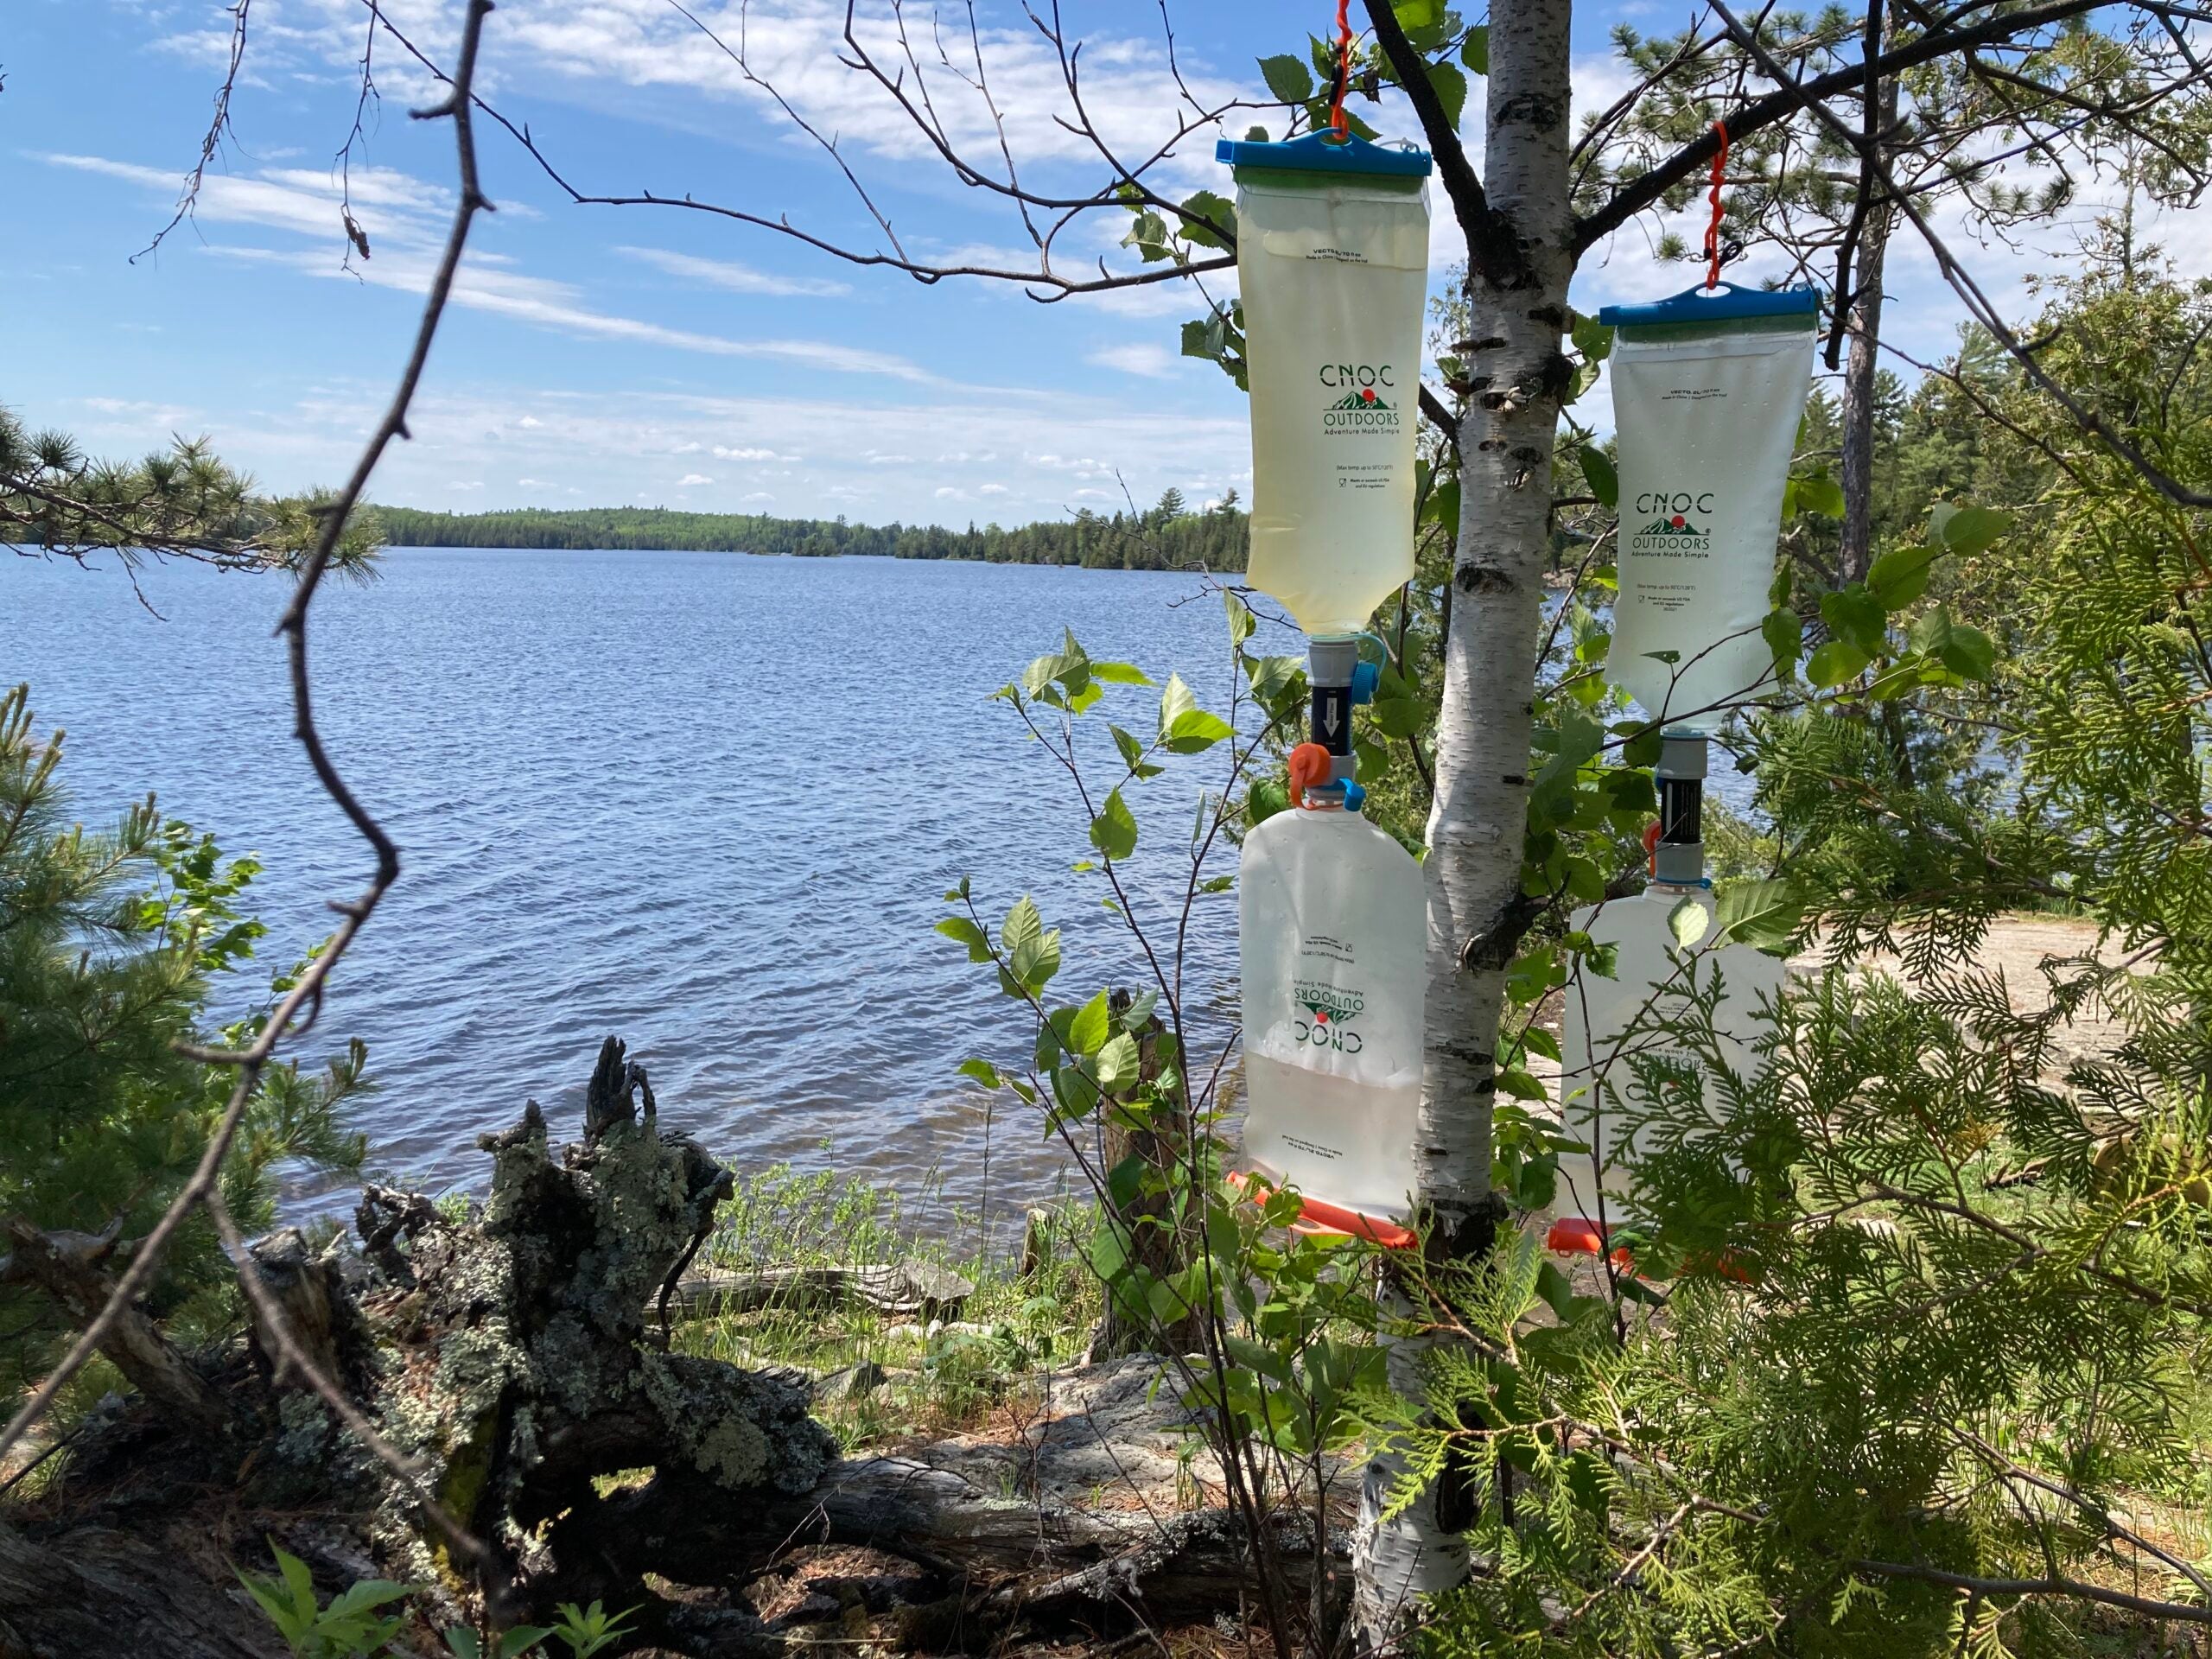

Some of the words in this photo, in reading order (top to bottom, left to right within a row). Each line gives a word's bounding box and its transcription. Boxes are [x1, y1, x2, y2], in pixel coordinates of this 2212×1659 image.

[1319, 364, 1395, 387] CNOC
[1324, 412, 1400, 426] OUTDOORS
[1636, 493, 1714, 514] CNOC
[1632, 537, 1709, 550] OUTDOORS
[1293, 978, 1314, 988] Simple
[1317, 982, 1332, 990] Made
[1333, 986, 1363, 997] Adventure
[1294, 988, 1364, 1011] OUTDOORS
[1294, 1020, 1363, 1053] CNOC
